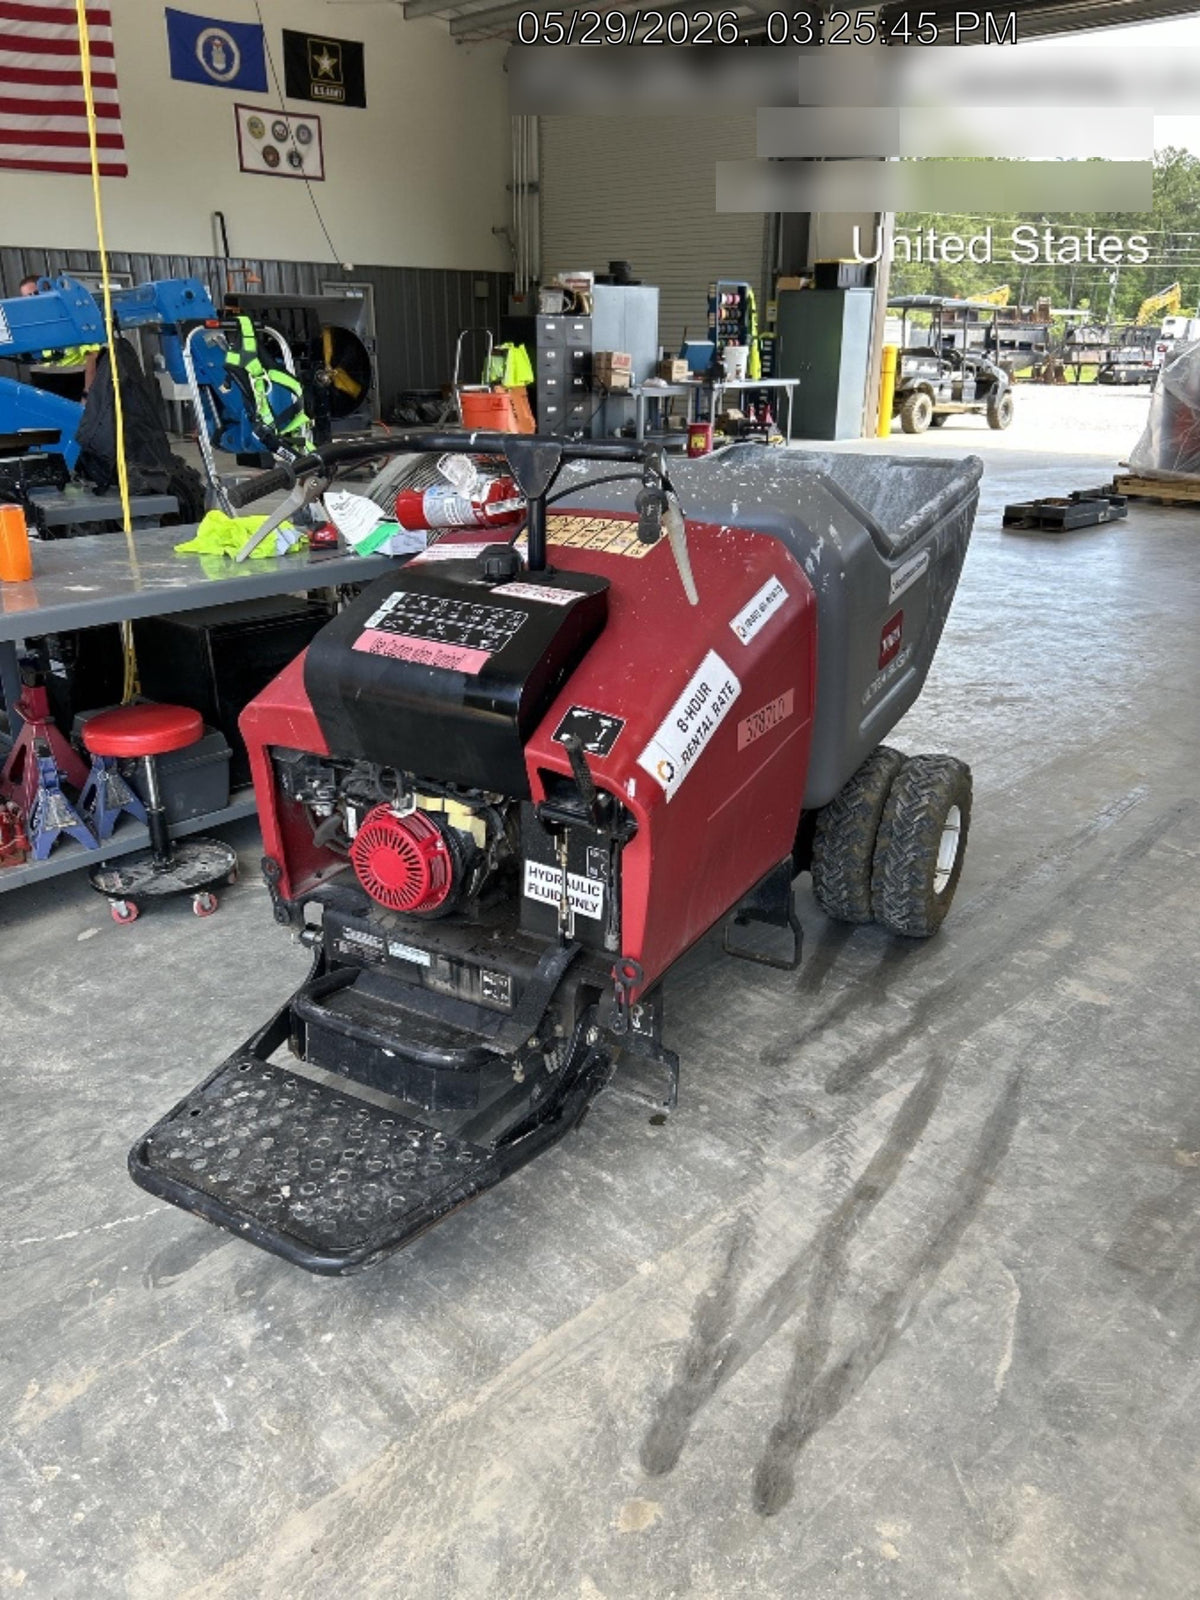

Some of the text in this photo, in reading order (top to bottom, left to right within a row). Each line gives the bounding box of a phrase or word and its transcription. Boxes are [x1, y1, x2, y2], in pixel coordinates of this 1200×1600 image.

[676, 681, 713, 733] 8-HOUR
[680, 680, 736, 766] RENTAL RATE
[746, 698, 785, 743] 378710
